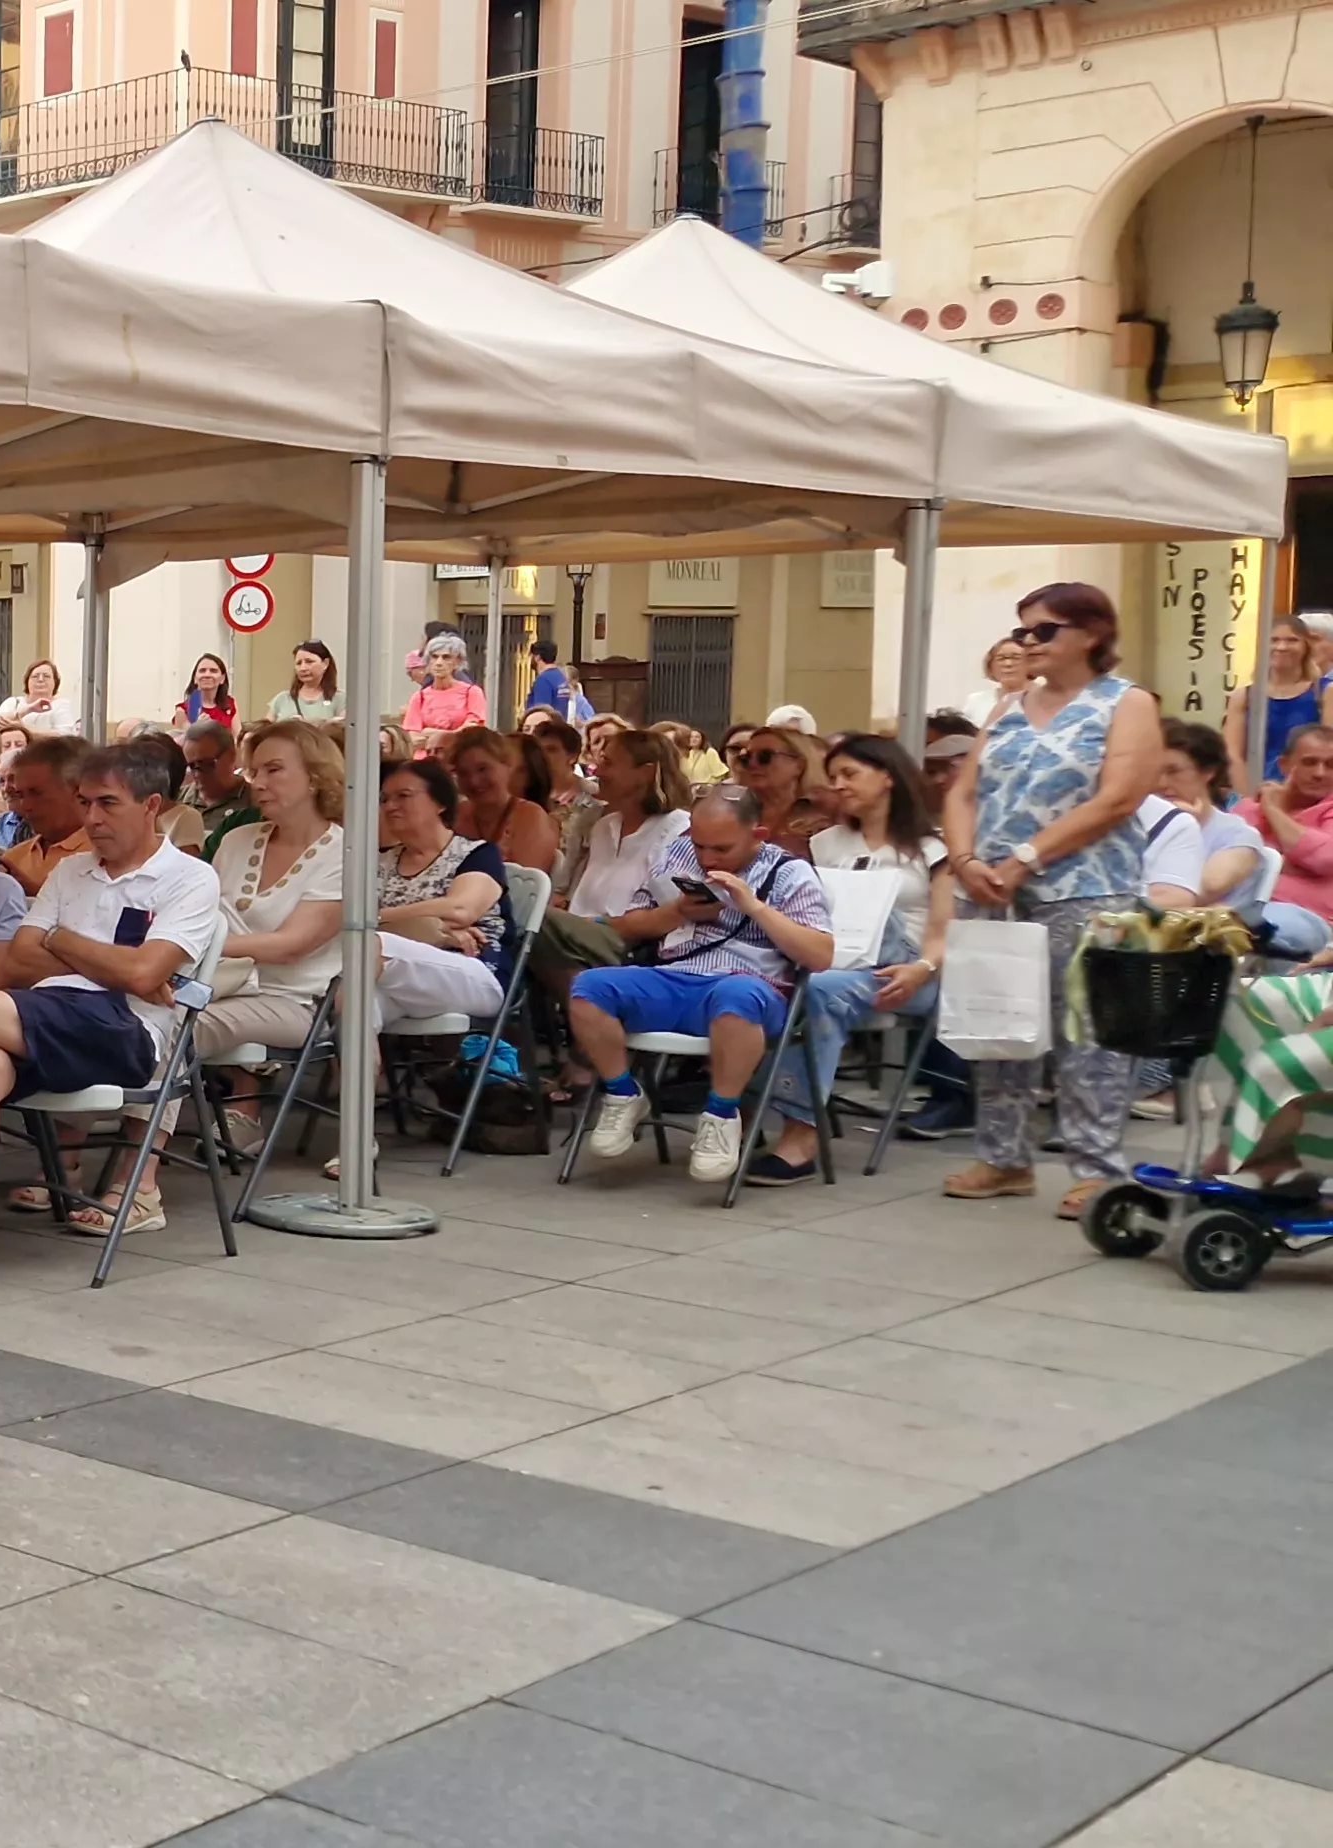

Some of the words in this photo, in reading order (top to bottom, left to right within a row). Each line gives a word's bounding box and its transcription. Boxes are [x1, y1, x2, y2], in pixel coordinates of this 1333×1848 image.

[666, 560, 721, 582] MONREAL
[1162, 542, 1182, 608] SIN
[1184, 568, 1209, 712] POESIA
